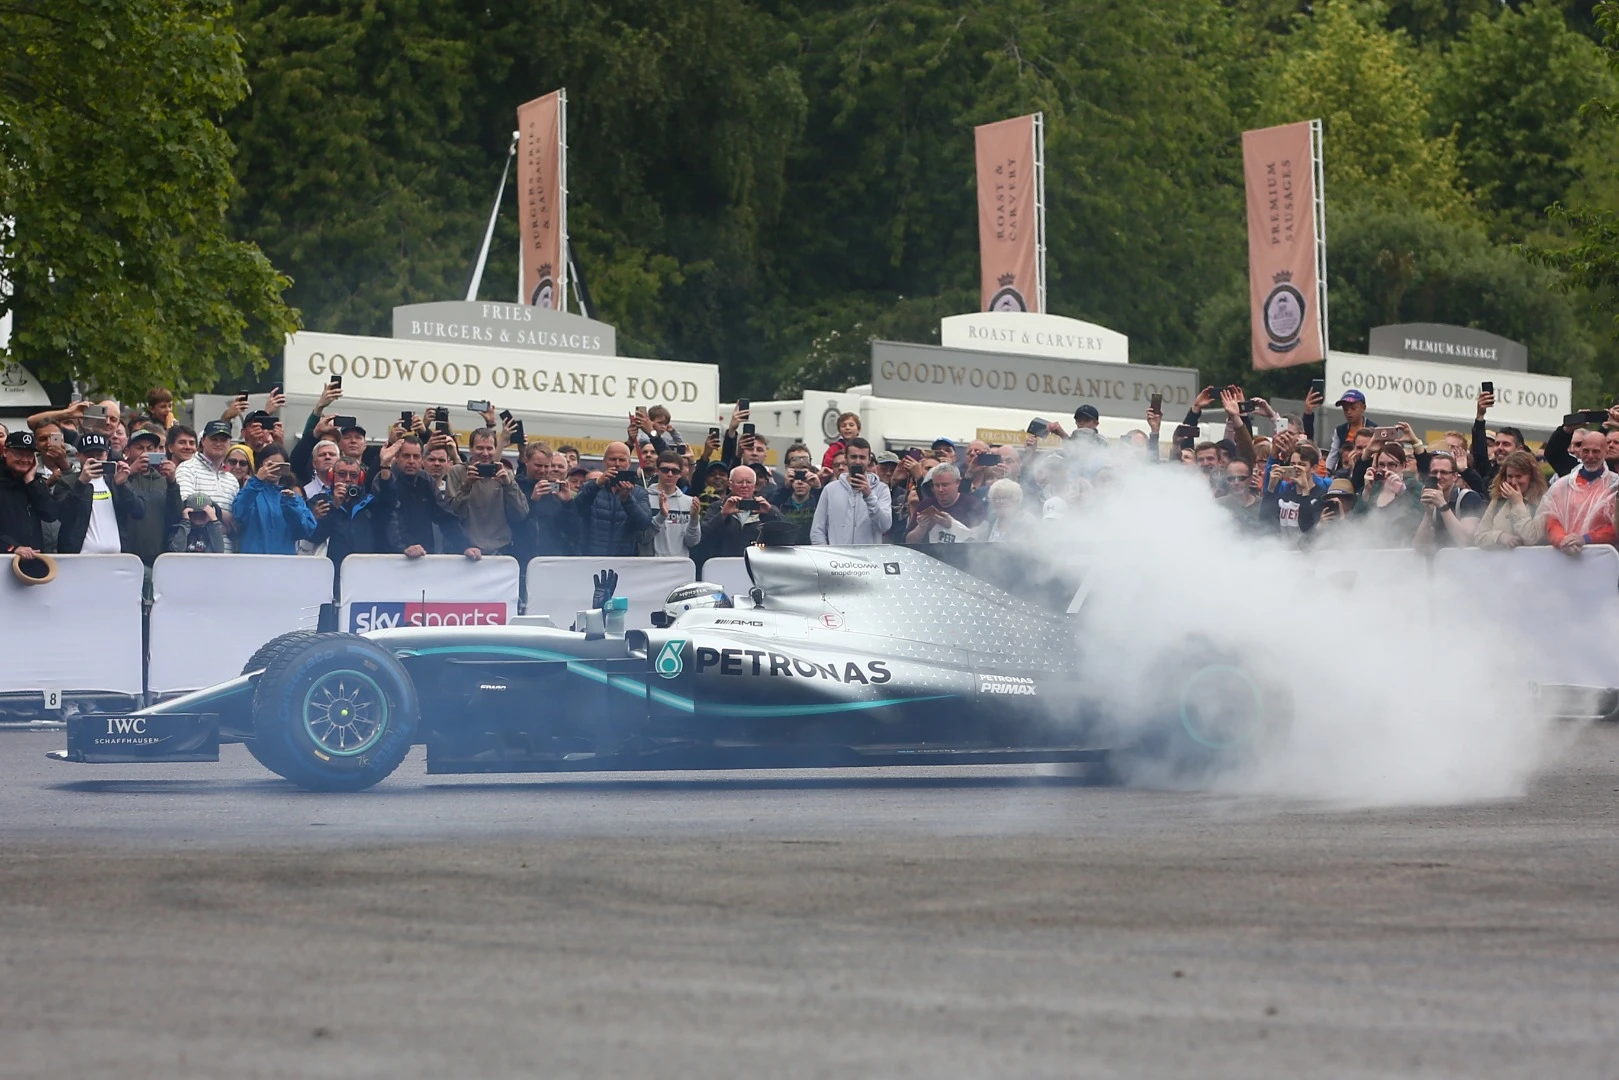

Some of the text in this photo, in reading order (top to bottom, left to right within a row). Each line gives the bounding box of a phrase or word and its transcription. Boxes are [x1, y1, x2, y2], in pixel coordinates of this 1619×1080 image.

[996, 184, 1005, 239] ROAST
[1008, 158, 1017, 242] CARVERY
[1266, 162, 1281, 245] PREMIUM
[1281, 159, 1294, 242] SAUSAGES
[482, 304, 532, 322] FRIES
[411, 320, 601, 351] BURGERS & SAUSAGES
[968, 325, 1104, 351] ROAST & CARVERY
[1404, 338, 1498, 361] PREMIUM SAUSAGE
[308, 352, 699, 403] GOODWOOD ORGANIC FOOD
[880, 360, 1191, 406] GOODWOOD ORGANIC FOOD
[1341, 371, 1559, 409] GOODWOOD ORGIC FOOD
[82, 435, 105, 446] ICON
[981, 431, 1022, 443] ORGANIC
[829, 560, 880, 569] Qualcomm
[356, 606, 400, 634] sky
[824, 614, 837, 627] E
[695, 646, 892, 685] PETRONAS
[979, 673, 1034, 684] PETRONAS
[980, 683, 1038, 696] PRIMAX
[49, 693, 57, 706] 8
[106, 718, 147, 734] IWC
[94, 737, 160, 745] SCHAFFHAUSEN
